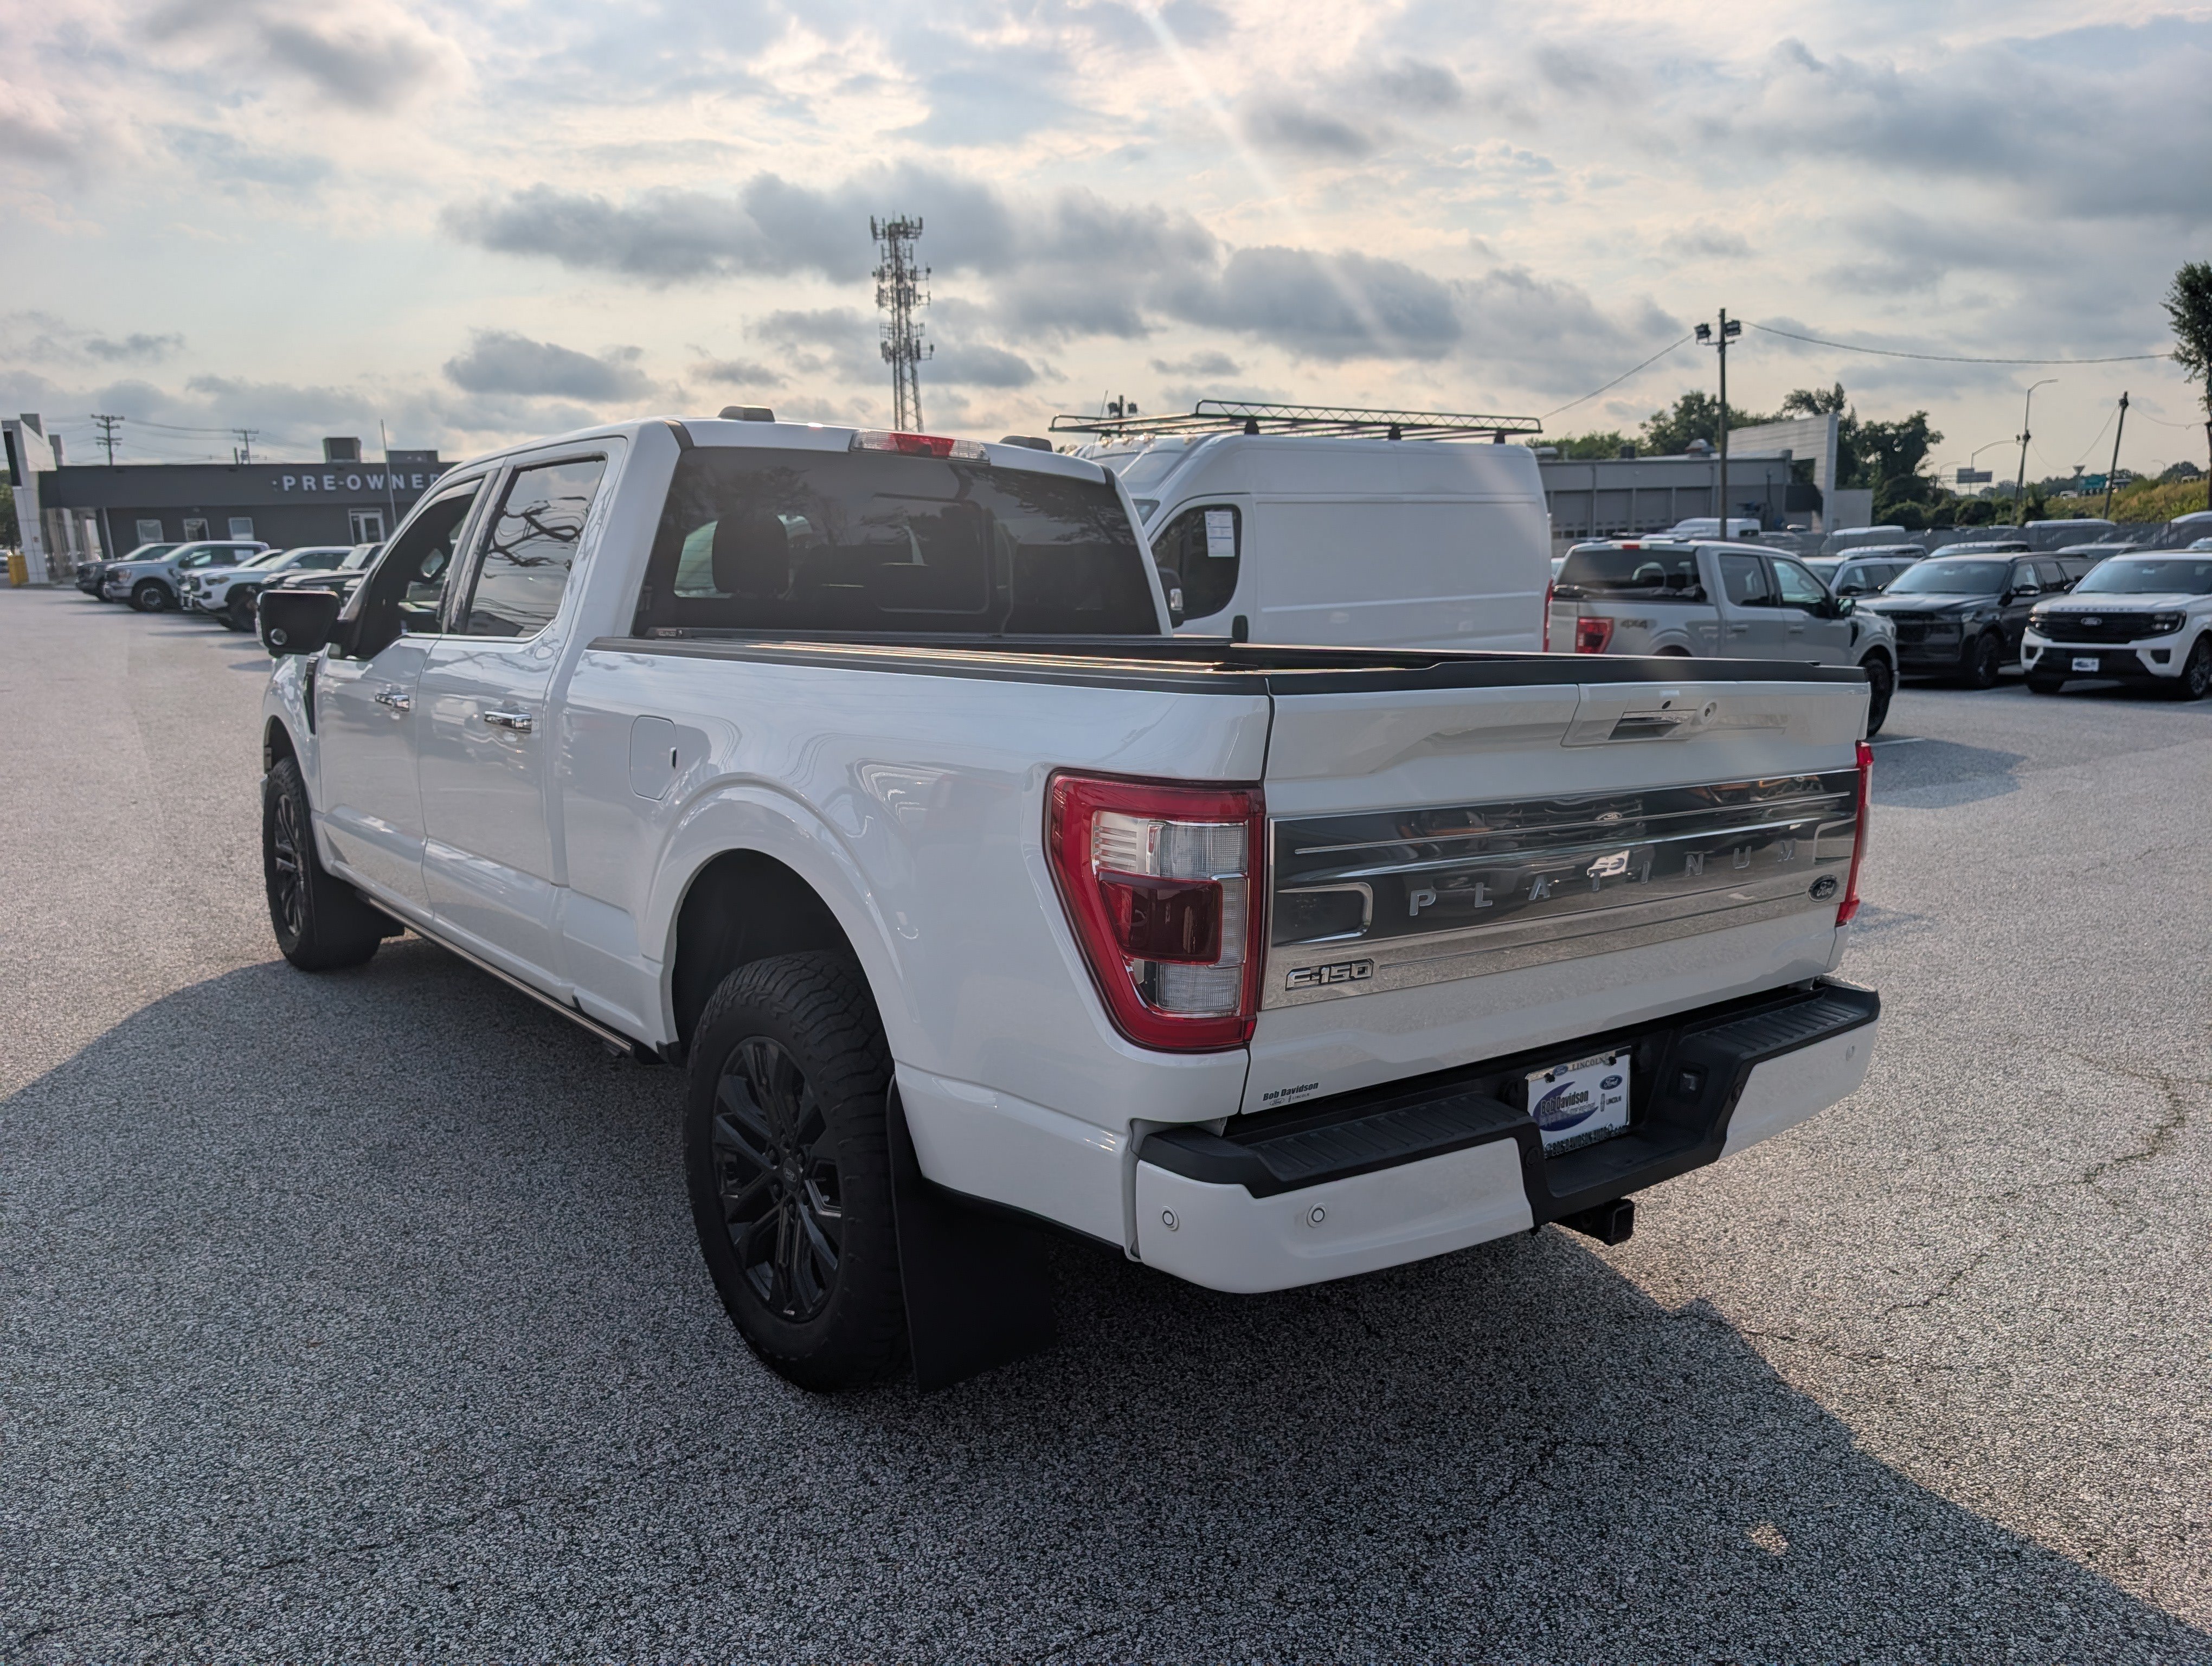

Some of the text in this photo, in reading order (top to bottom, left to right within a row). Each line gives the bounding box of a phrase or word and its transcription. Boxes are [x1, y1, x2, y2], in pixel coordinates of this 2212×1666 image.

[1409, 838, 1795, 917] PLATINUM
[1285, 958, 1375, 991] F-150
[1263, 1082, 1319, 1101] Bob Davidson
[1540, 1097, 1556, 1116] Bob
[1555, 1090, 1589, 1110] Davidson
[1606, 1095, 1622, 1105] LINCOLN
